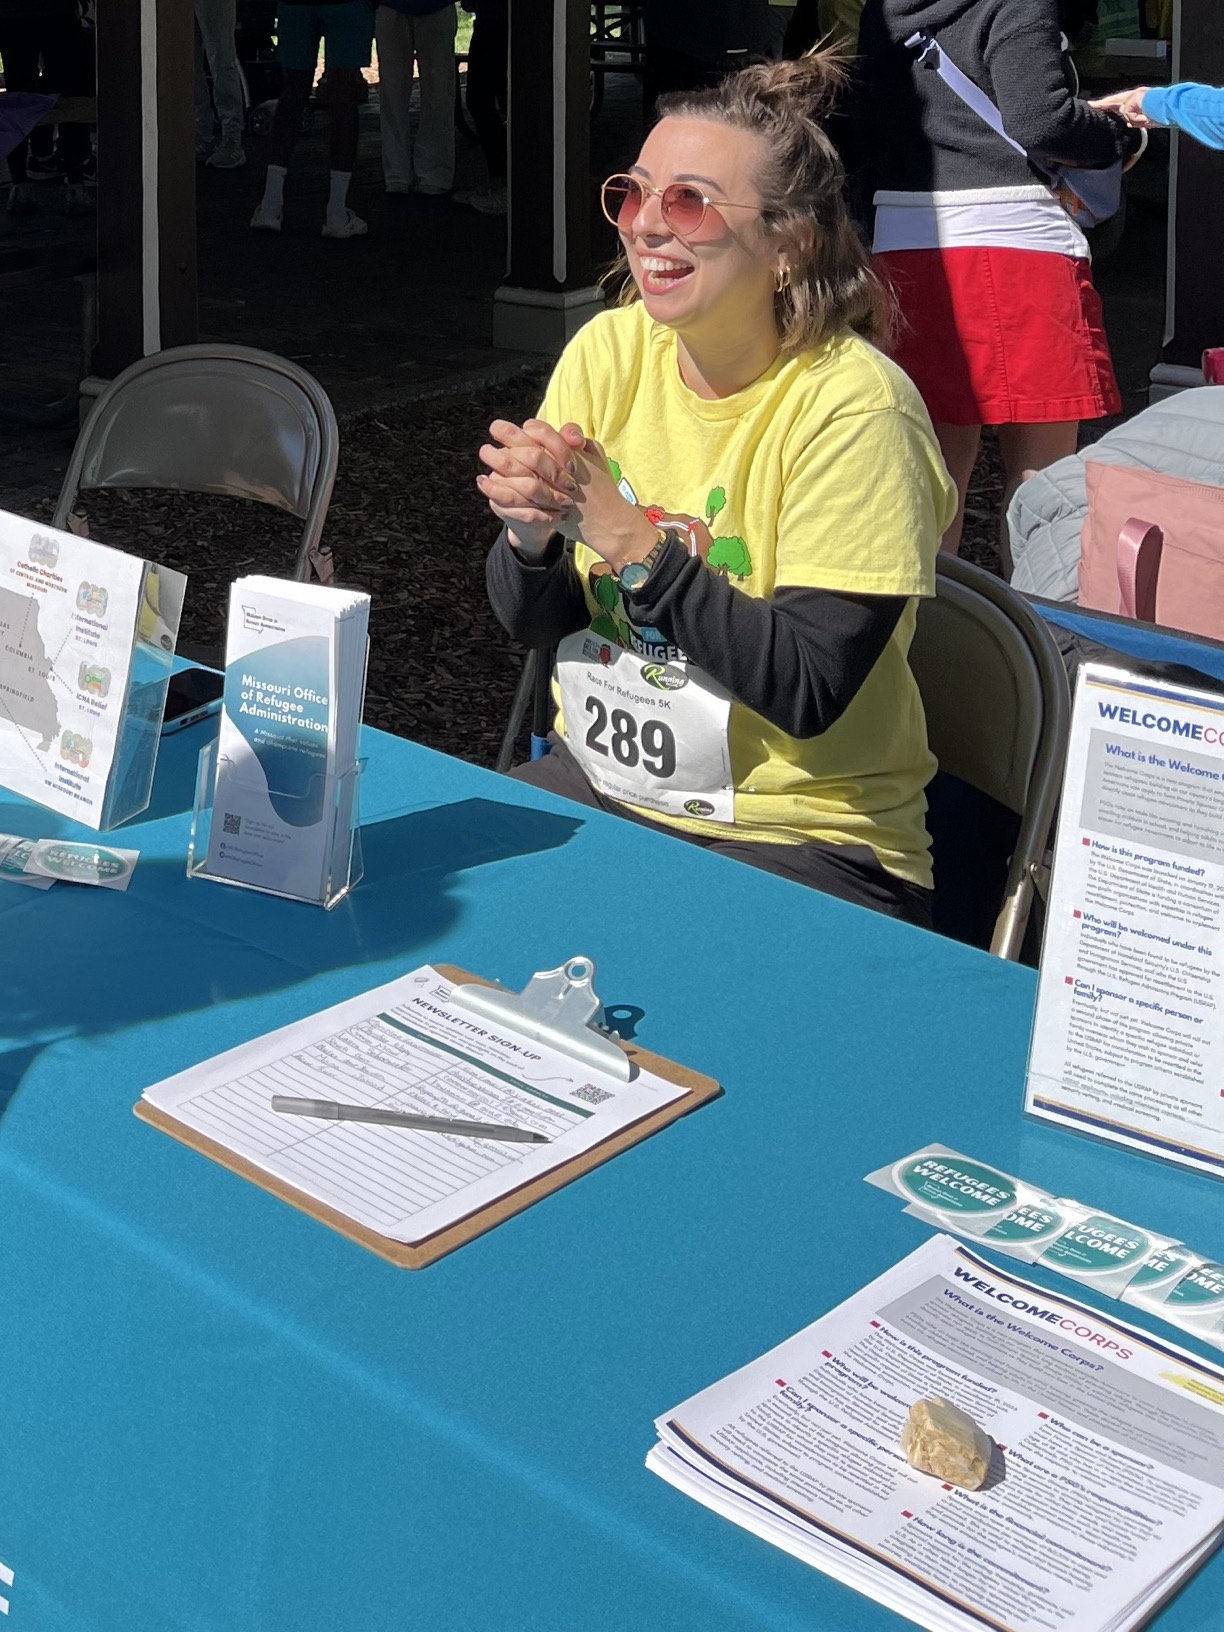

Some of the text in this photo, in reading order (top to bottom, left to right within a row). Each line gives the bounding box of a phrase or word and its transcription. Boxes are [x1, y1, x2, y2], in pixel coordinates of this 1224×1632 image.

[241, 675, 328, 705] Missouri Office
[241, 689, 304, 714] of Refugee
[587, 671, 671, 709] Race For Refugees 5K
[239, 703, 329, 731] Administration
[585, 695, 676, 778] 289
[1104, 743, 1220, 779] What is the Welcome
[1091, 840, 1110, 851] How
[1118, 847, 1133, 857] this
[1133, 853, 1170, 868] program
[1171, 861, 1205, 876] funded?
[1081, 923, 1121, 938] program?
[1082, 912, 1212, 955] Who will be welcomed under this
[1072, 987, 1103, 1002] family?
[1074, 979, 1090, 989] Can
[1095, 987, 1127, 1000] sponsor
[1135, 998, 1163, 1012] specific
[1164, 1007, 1192, 1020] person
[413, 997, 541, 1061] NEWSLETTER SIGN-UP
[911, 1166, 1001, 1206] WELCOME
[922, 1160, 1011, 1199] REFUGEES
[943, 1288, 974, 1310] What
[986, 1312, 1004, 1327] the
[1007, 1319, 1058, 1354] Welcome
[1060, 1345, 1103, 1376] Corps?
[953, 1266, 1133, 1361] WELCOMECORPS
[823, 1362, 868, 1390] program?
[831, 1356, 852, 1373] Who
[852, 1370, 869, 1383] will
[879, 1326, 900, 1342] How
[907, 1342, 923, 1356] this
[921, 1352, 960, 1378] program
[961, 1372, 996, 1396] funded?
[778, 1389, 812, 1413] family?
[784, 1385, 803, 1400] Can
[806, 1402, 840, 1425] sponsor
[847, 1427, 877, 1448] specific
[1007, 1449, 1033, 1466] What
[1049, 1417, 1071, 1432] Who
[1072, 1430, 1088, 1441] can
[1110, 1446, 1153, 1474] sponsor?
[953, 1489, 979, 1506] What
[988, 1507, 1004, 1519] the
[1004, 1516, 1045, 1540] financial
[912, 1516, 935, 1531] How
[935, 1529, 957, 1546] long
[966, 1547, 982, 1559] the
